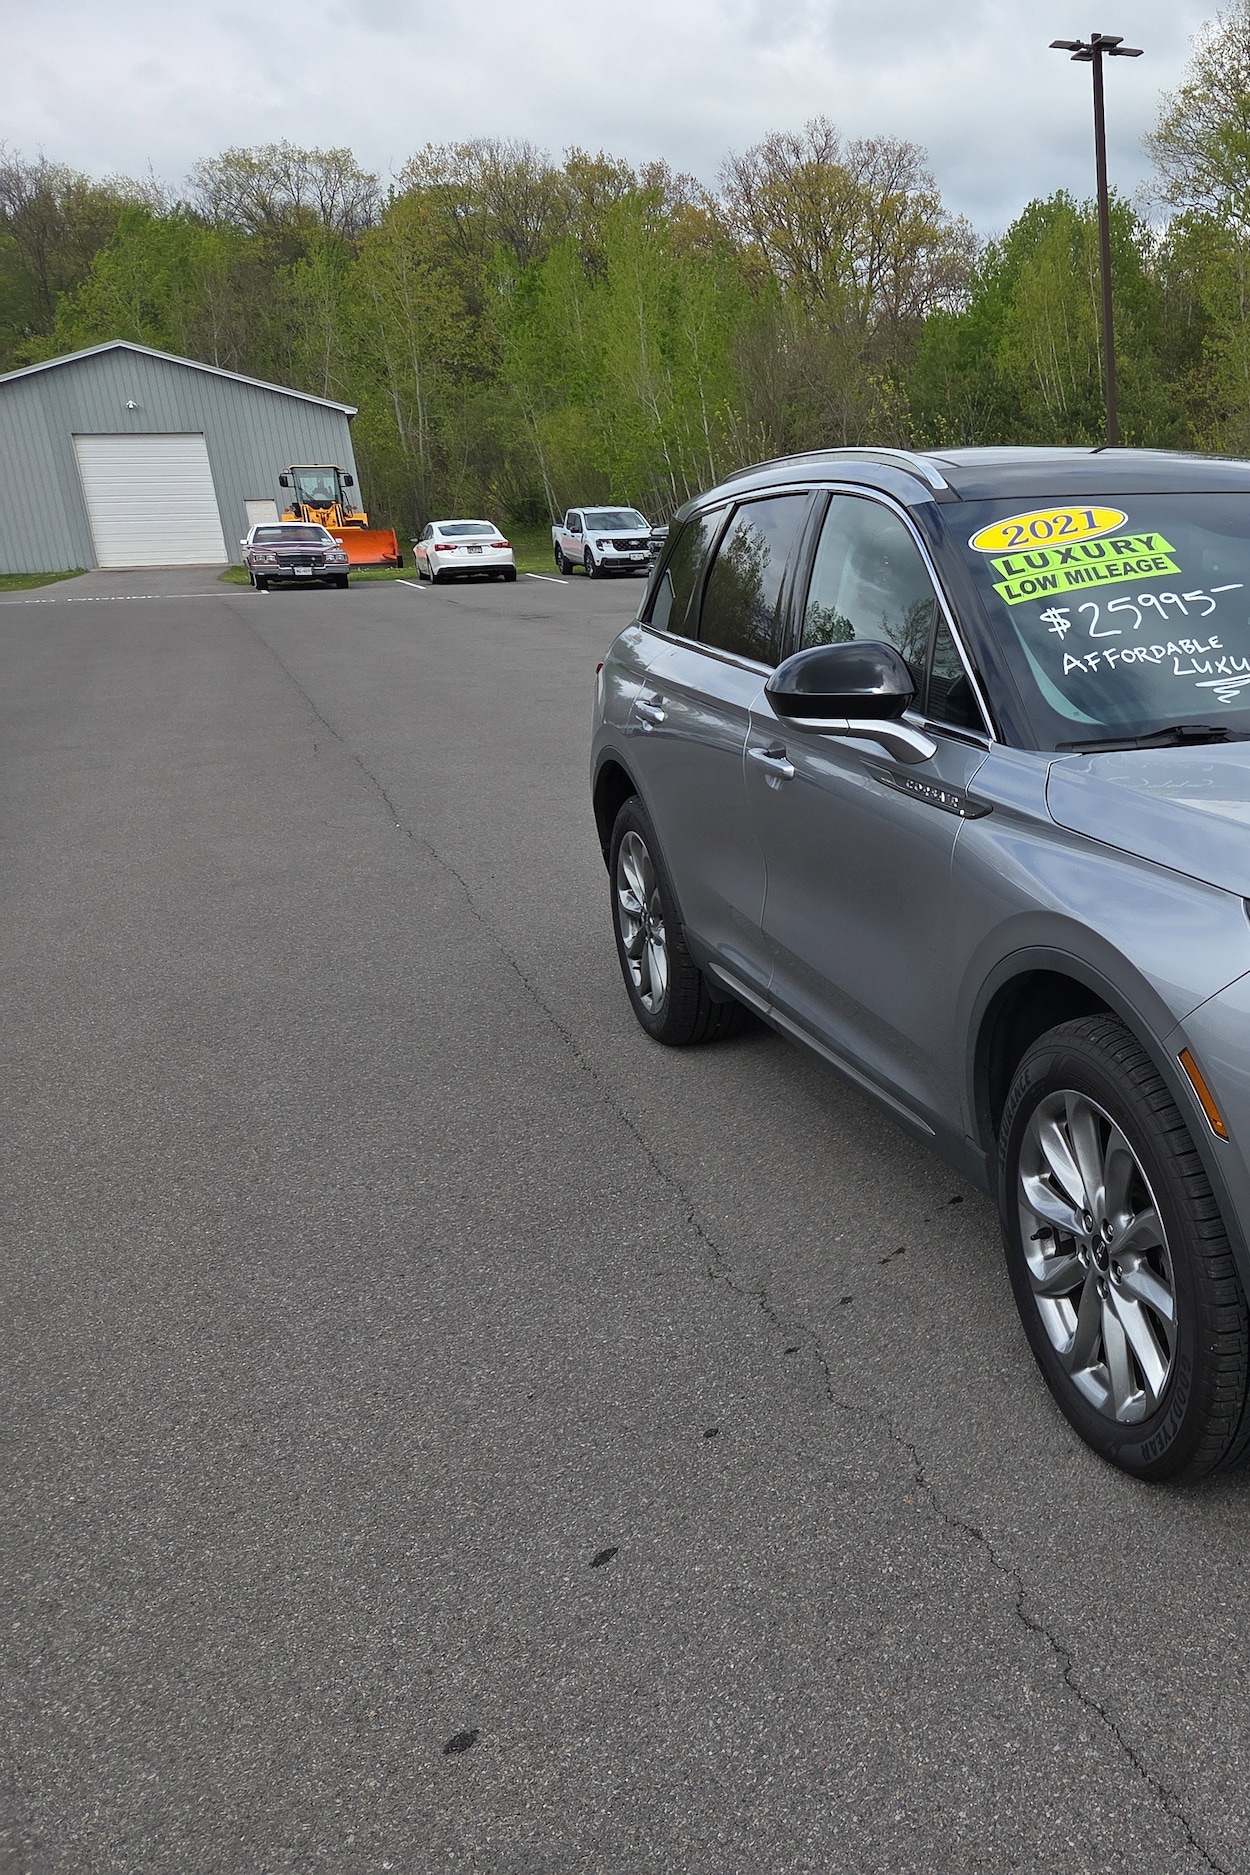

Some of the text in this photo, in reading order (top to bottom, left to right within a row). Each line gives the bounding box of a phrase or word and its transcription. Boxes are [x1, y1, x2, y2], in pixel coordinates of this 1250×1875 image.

[1002, 510, 1102, 547] 2021
[1002, 535, 1157, 576] LUXURY
[1004, 557, 1169, 600] LOW MILEAGE
[1062, 635, 1224, 676] AFFORDABLE
